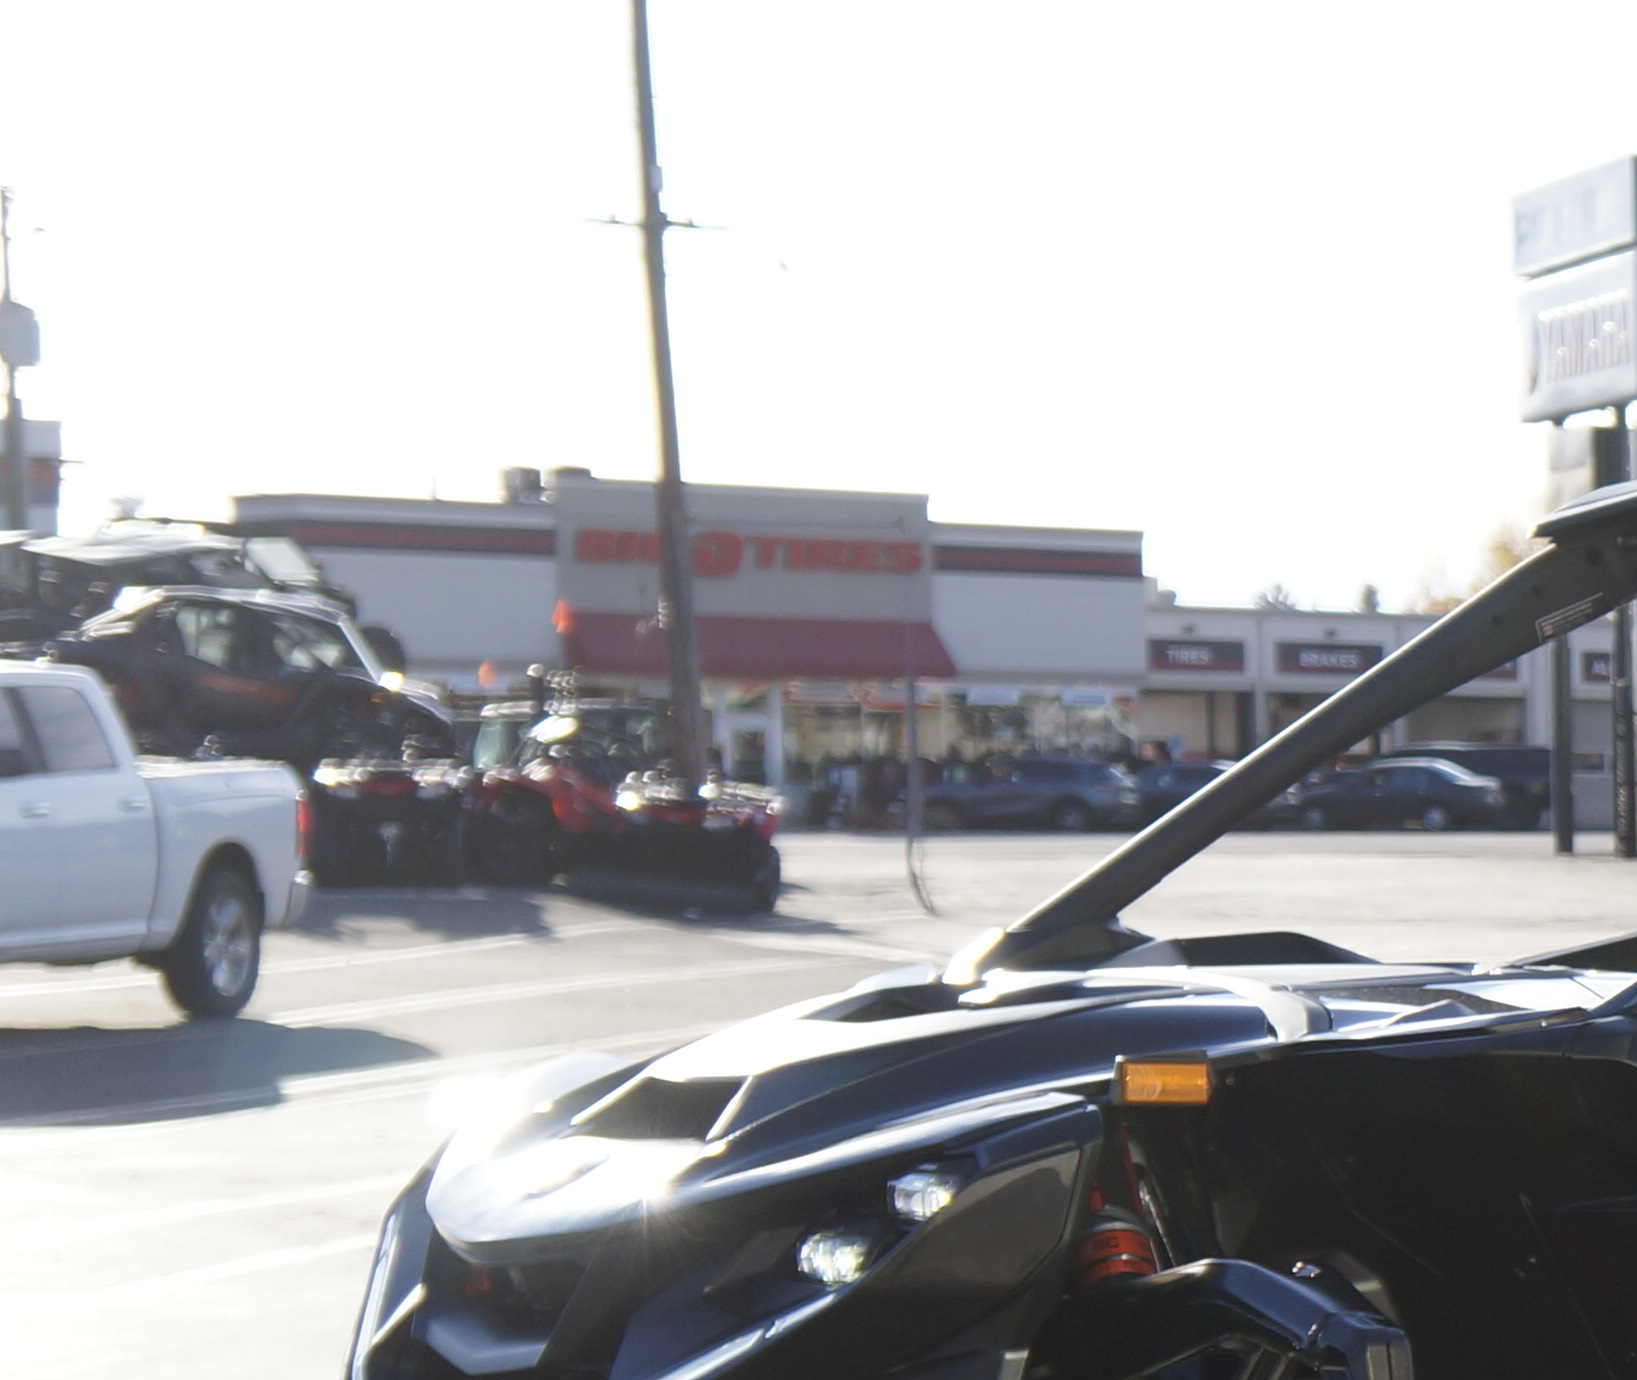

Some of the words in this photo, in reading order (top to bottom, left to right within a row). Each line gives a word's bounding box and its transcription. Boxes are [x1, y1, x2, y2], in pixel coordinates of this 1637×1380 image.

[745, 536, 923, 573] TIRES
[1166, 649, 1209, 664] TIRES
[1299, 652, 1358, 668] BRAKES
